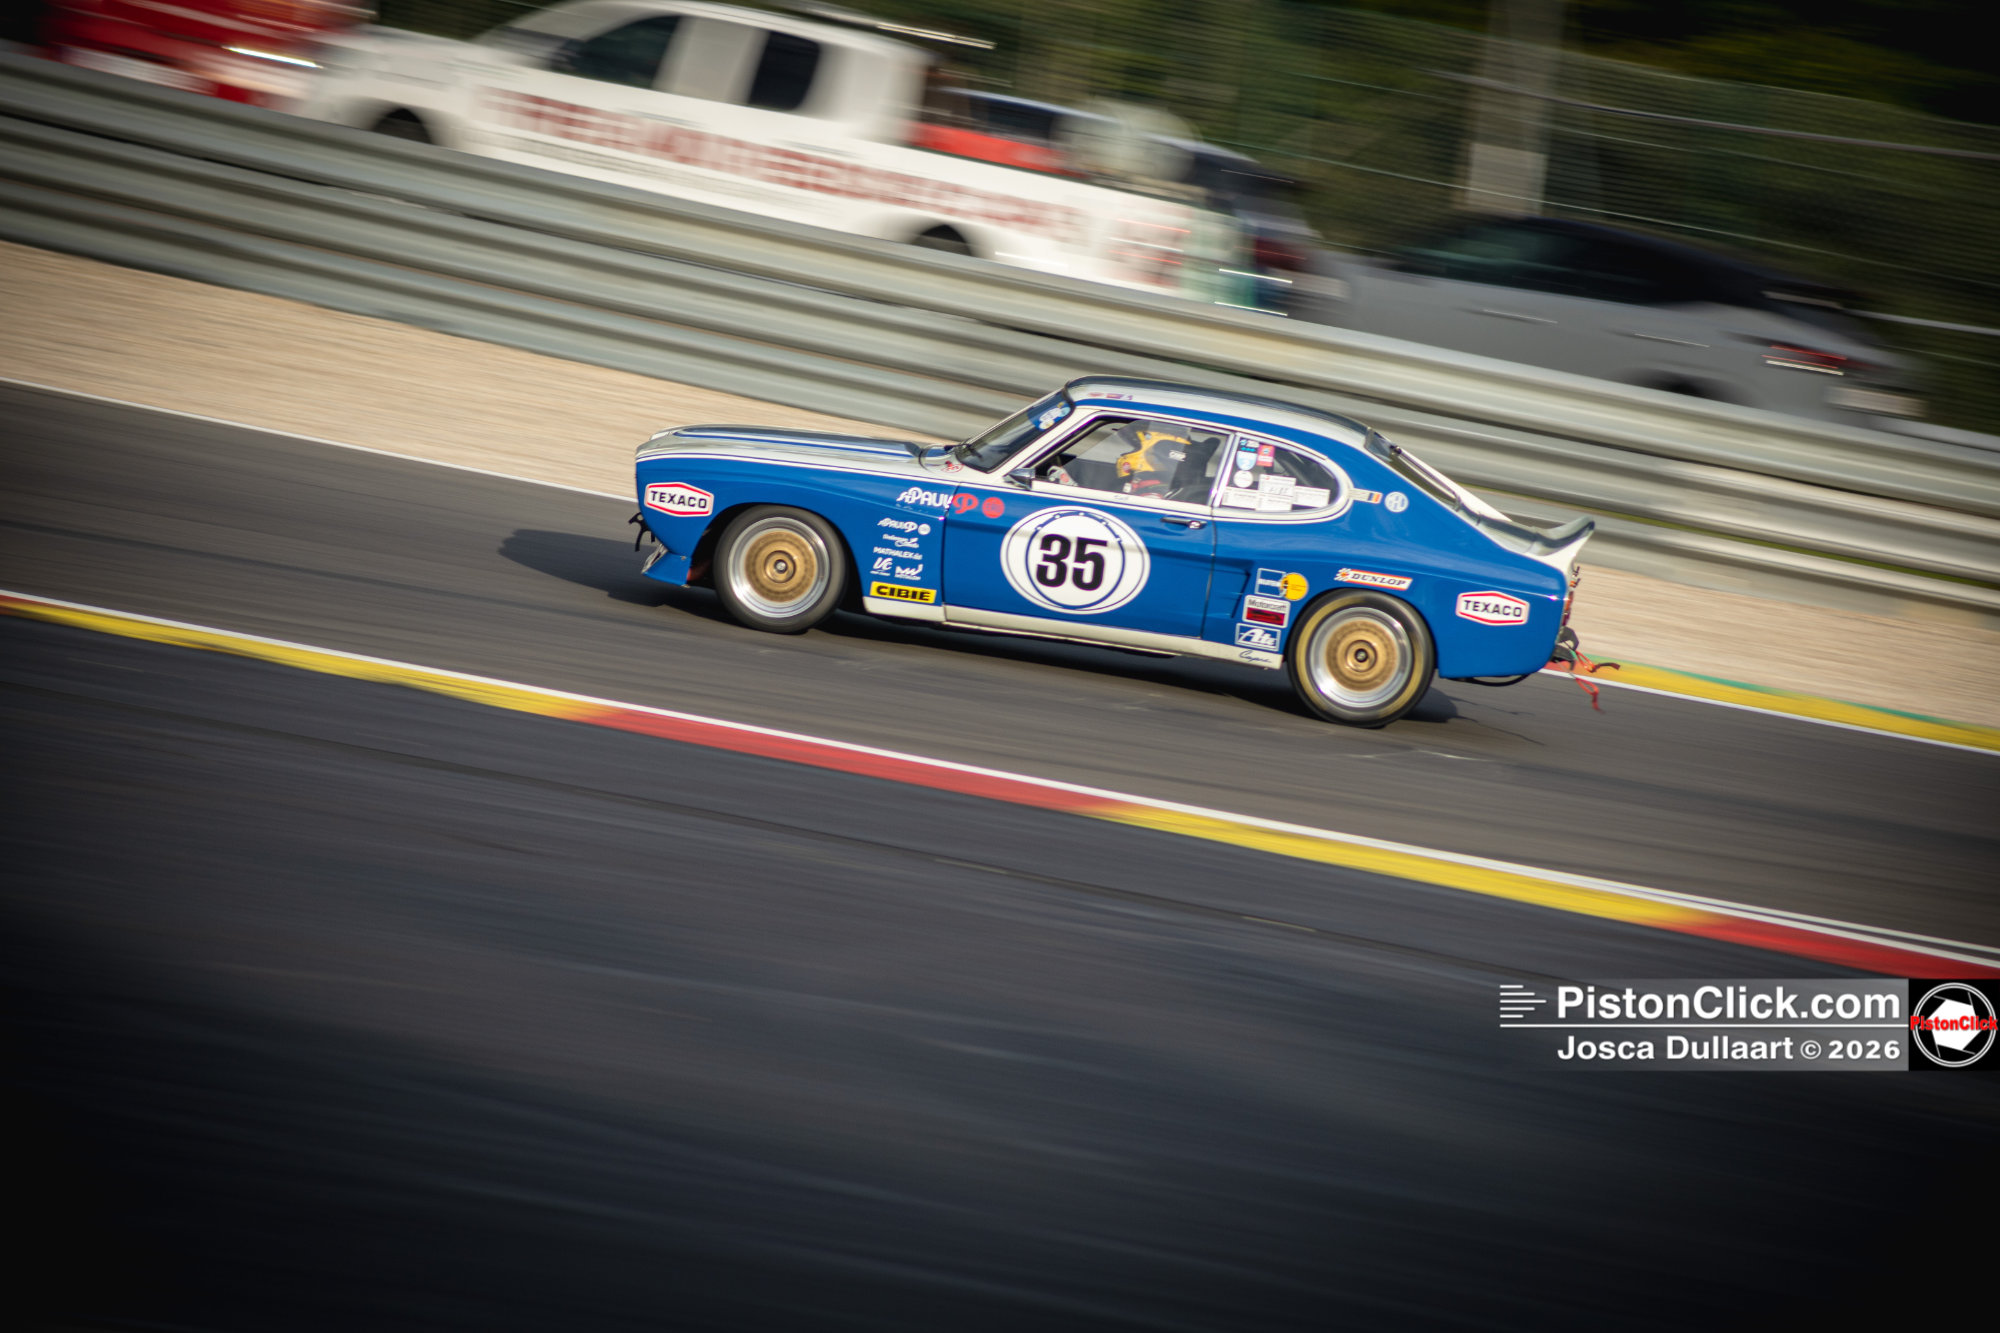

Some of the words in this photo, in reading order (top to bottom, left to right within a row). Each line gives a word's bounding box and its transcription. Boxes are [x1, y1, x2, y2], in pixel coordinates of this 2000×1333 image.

[650, 490, 707, 509] TEXACO
[1036, 533, 1109, 591] 35
[1351, 573, 1407, 586] DUNLOP
[876, 585, 931, 601] CIBIE
[1463, 599, 1523, 618] TEXACO
